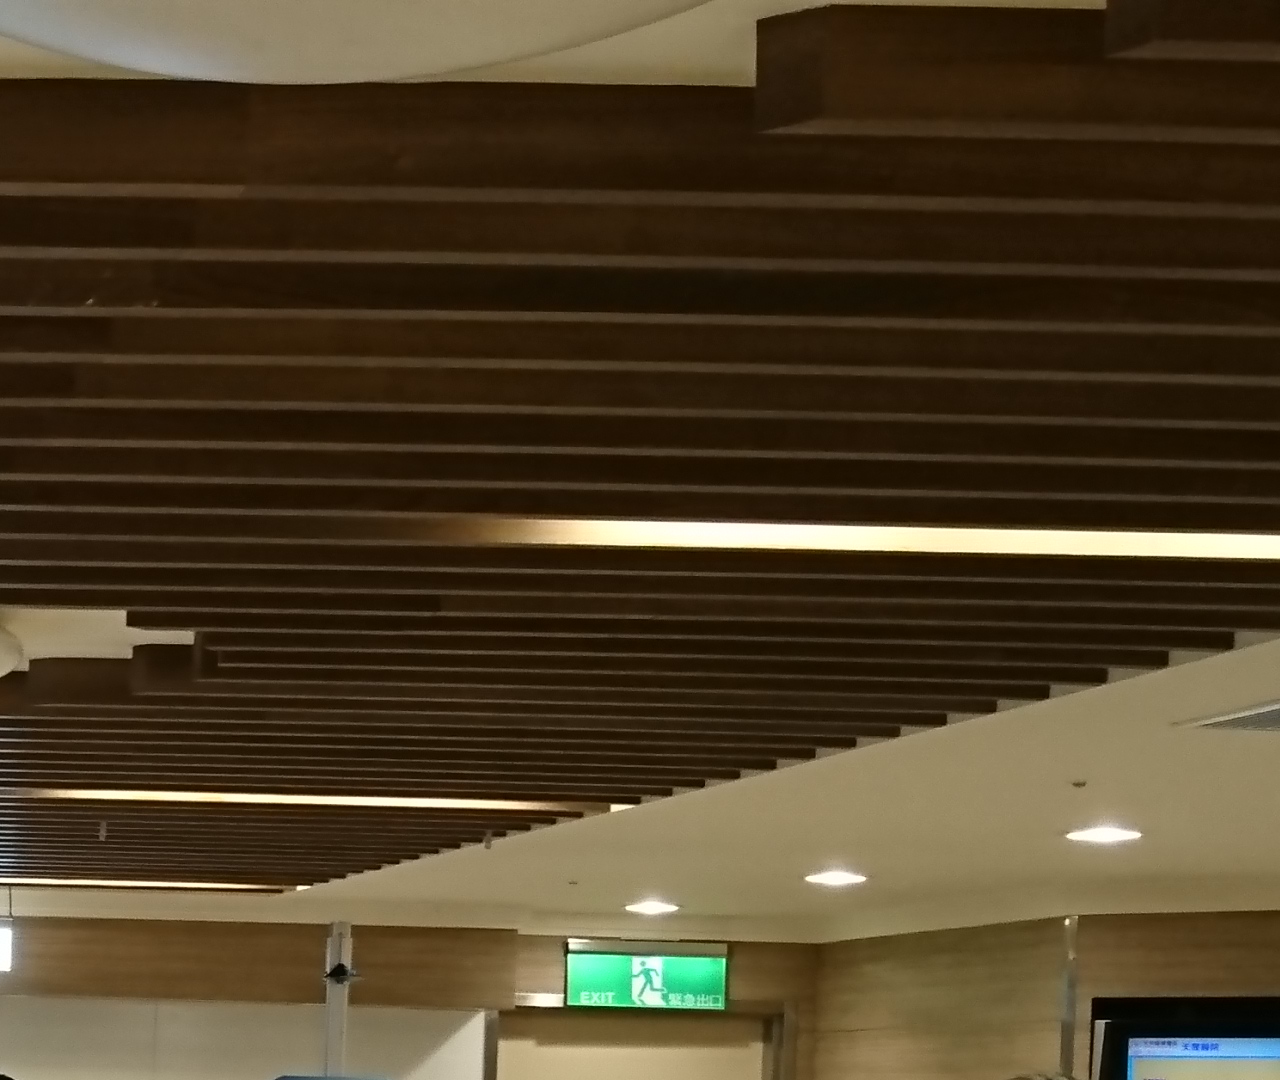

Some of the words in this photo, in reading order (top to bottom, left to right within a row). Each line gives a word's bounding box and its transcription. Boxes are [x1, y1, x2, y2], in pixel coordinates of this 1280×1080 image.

[580, 991, 615, 1004] EXIT
[669, 993, 721, 1006] 緊急出口
